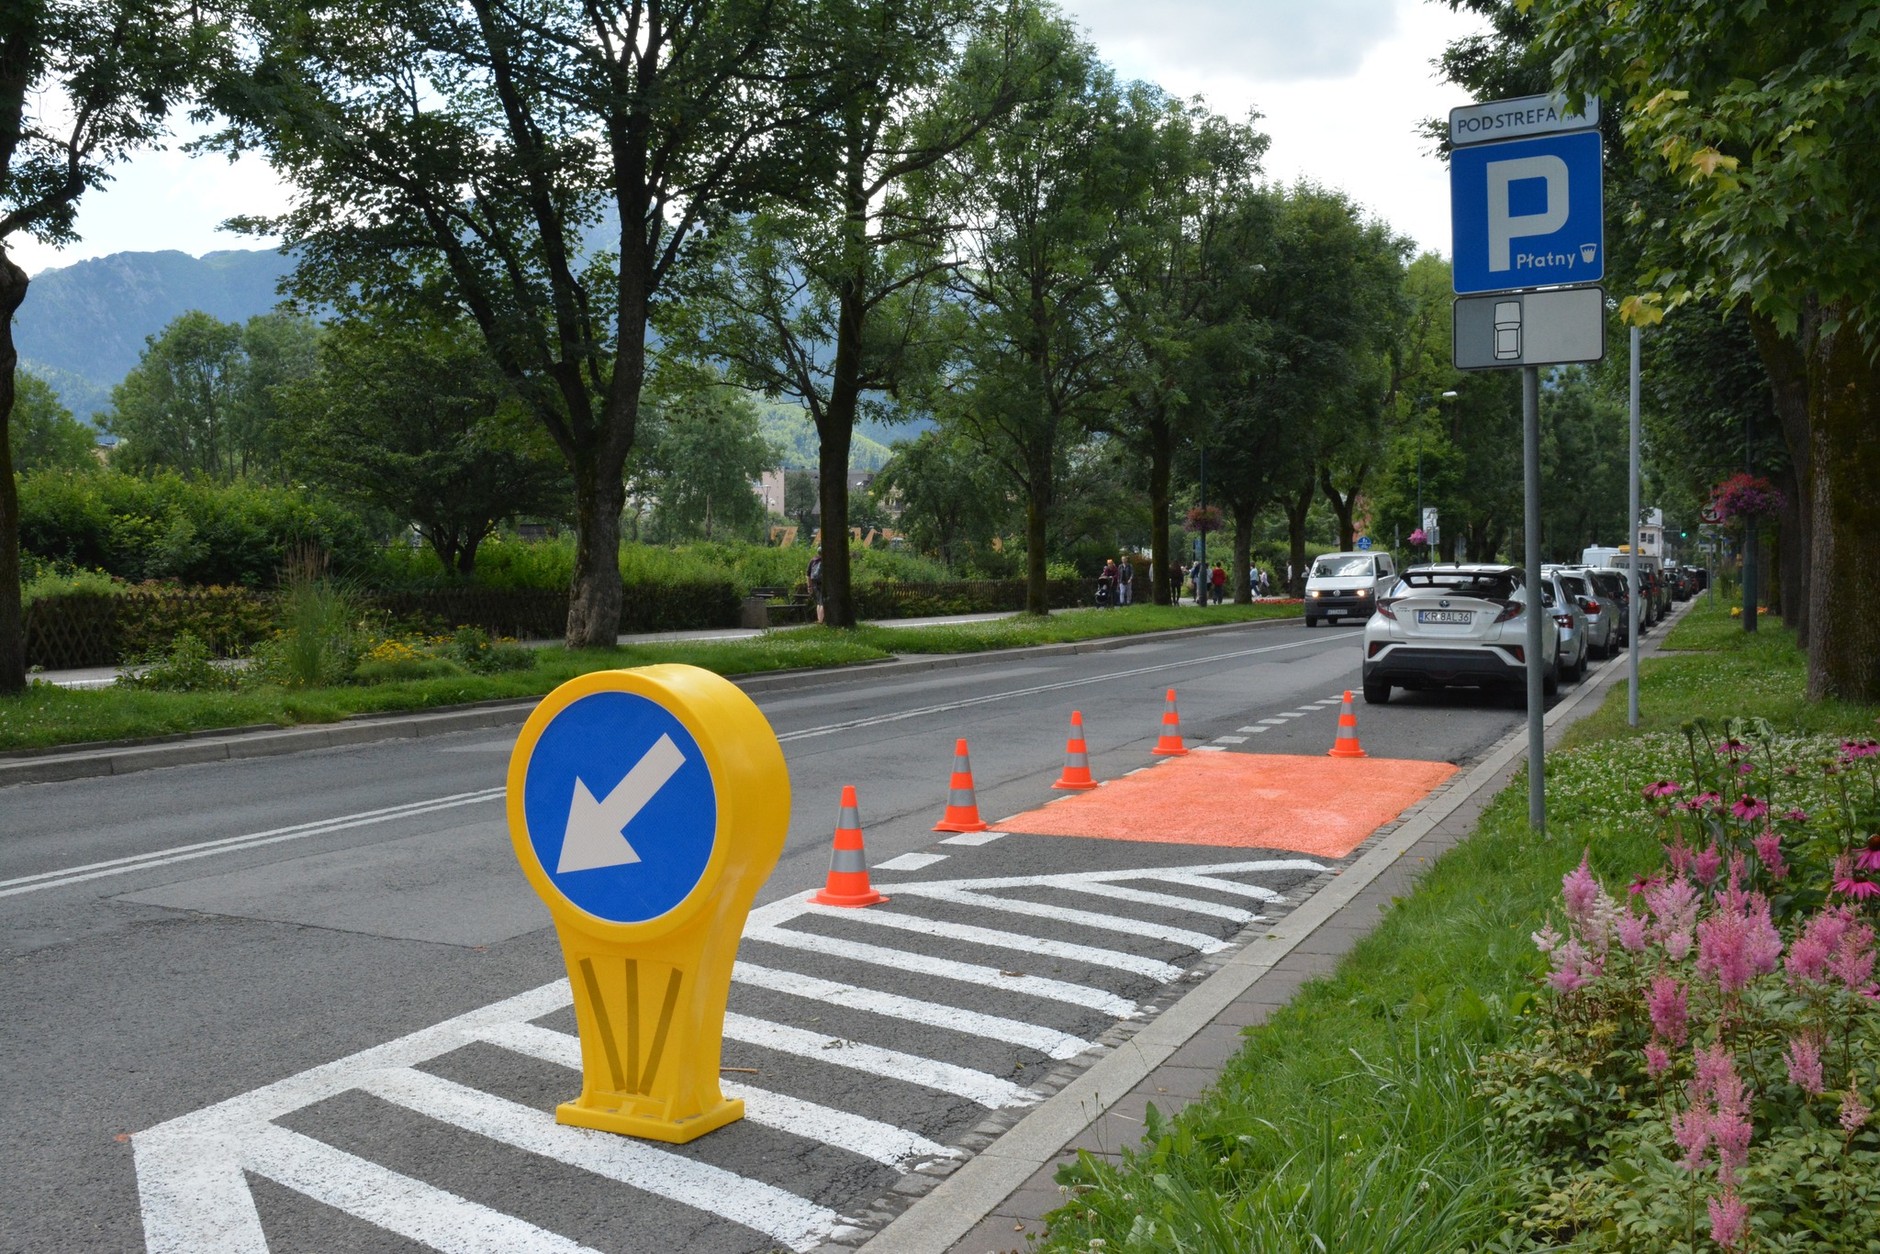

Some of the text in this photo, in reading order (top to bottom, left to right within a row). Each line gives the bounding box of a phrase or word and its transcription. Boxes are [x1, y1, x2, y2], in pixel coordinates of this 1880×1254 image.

[1457, 107, 1557, 134] PODSTREFA
[1486, 154, 1570, 273] P
[1516, 251, 1576, 270] Płatny
[1424, 612, 1438, 621] KR
